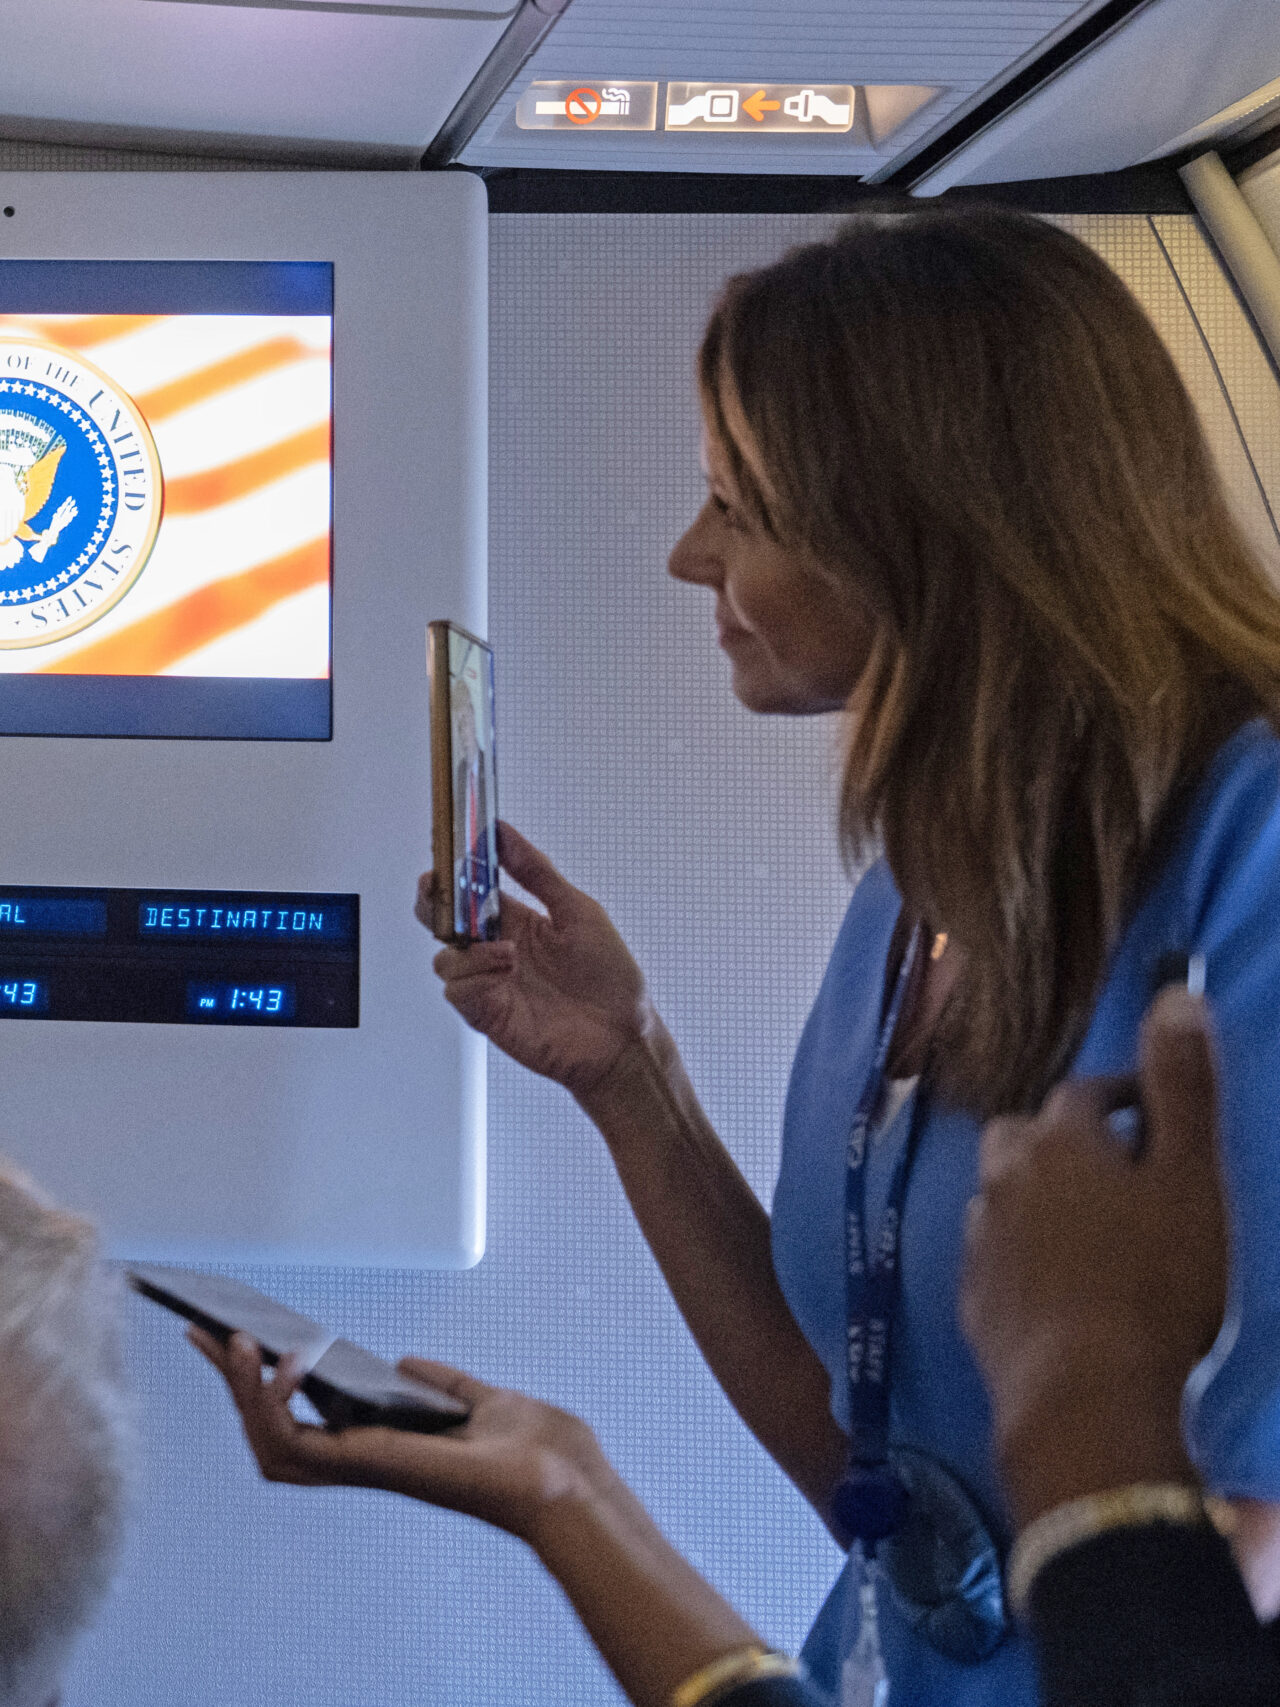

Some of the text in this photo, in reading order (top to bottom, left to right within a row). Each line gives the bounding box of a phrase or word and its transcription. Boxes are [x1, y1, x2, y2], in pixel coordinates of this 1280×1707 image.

[87, 388, 147, 512] UNITED
[30, 538, 133, 626] STATES
[144, 906, 324, 931] DESTINATION
[199, 988, 283, 1012] PM 1:43
